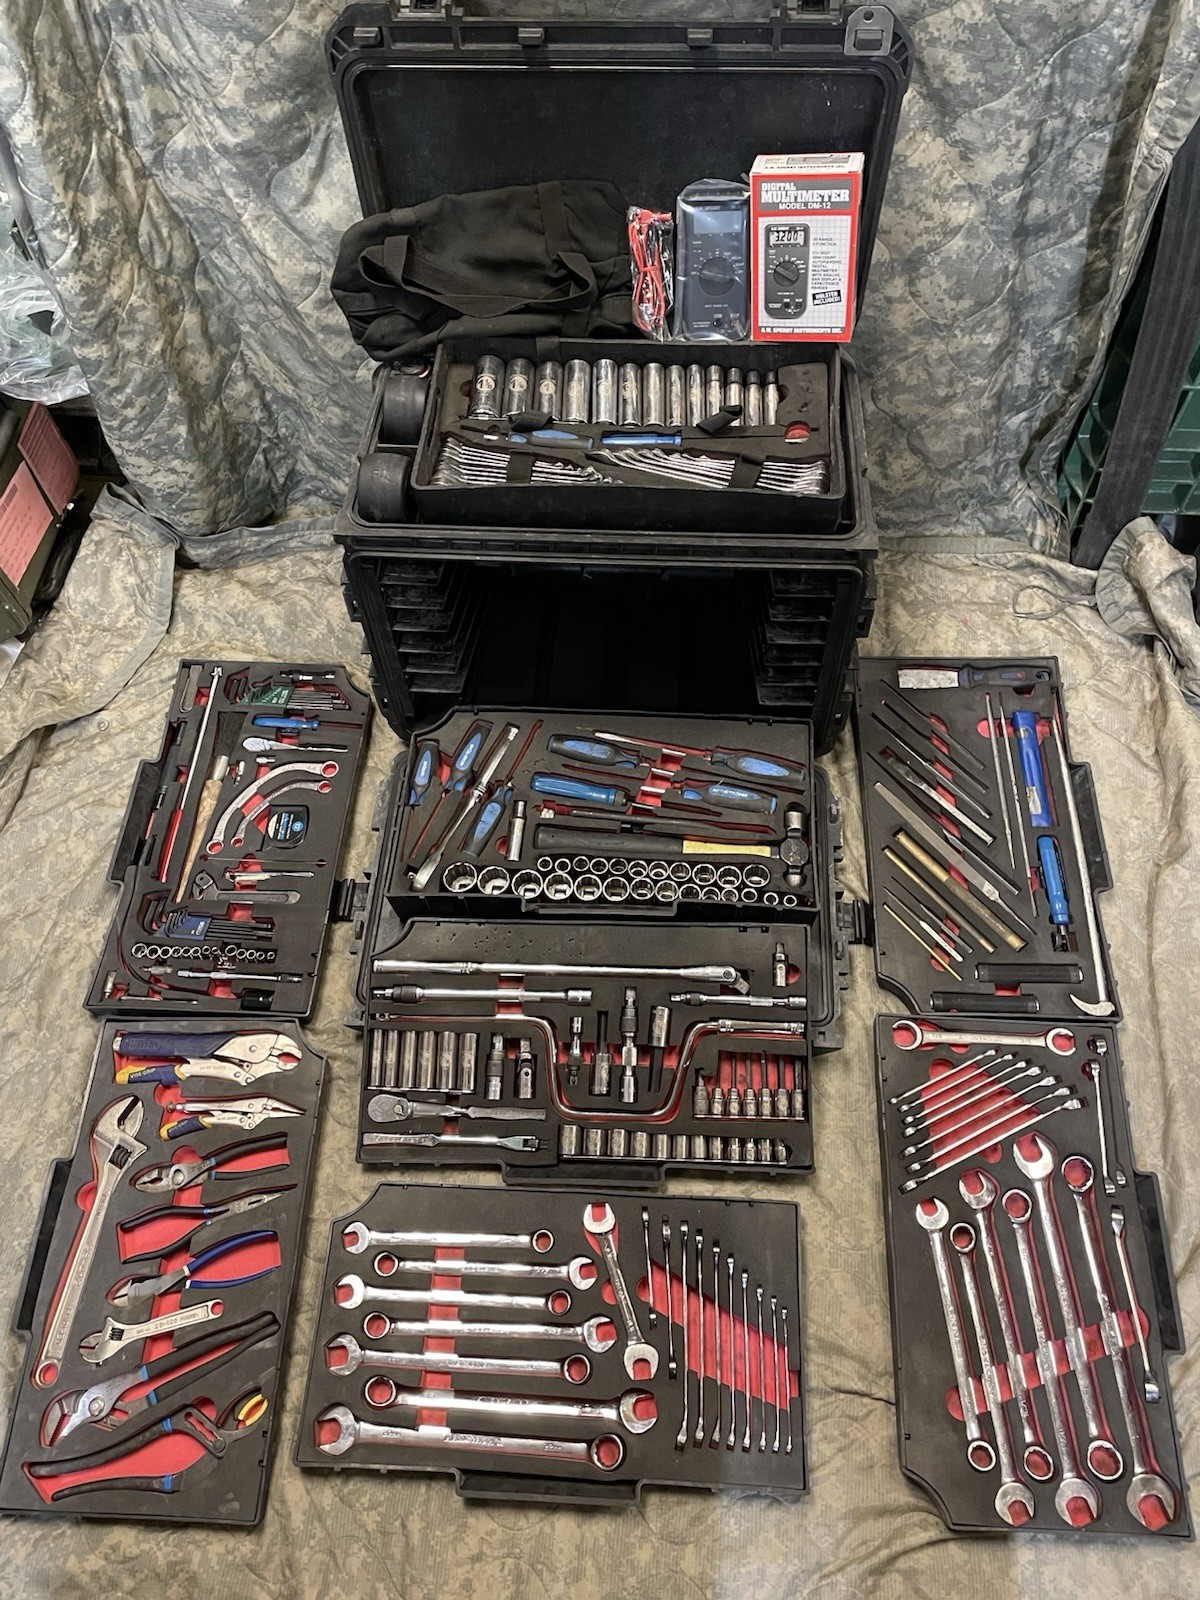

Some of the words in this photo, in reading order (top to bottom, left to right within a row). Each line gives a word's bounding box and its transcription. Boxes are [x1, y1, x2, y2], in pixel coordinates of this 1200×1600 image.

[761, 182, 796, 191] DIGITAL
[760, 189, 850, 203] MULTIMETER
[778, 202, 806, 210] MODEL
